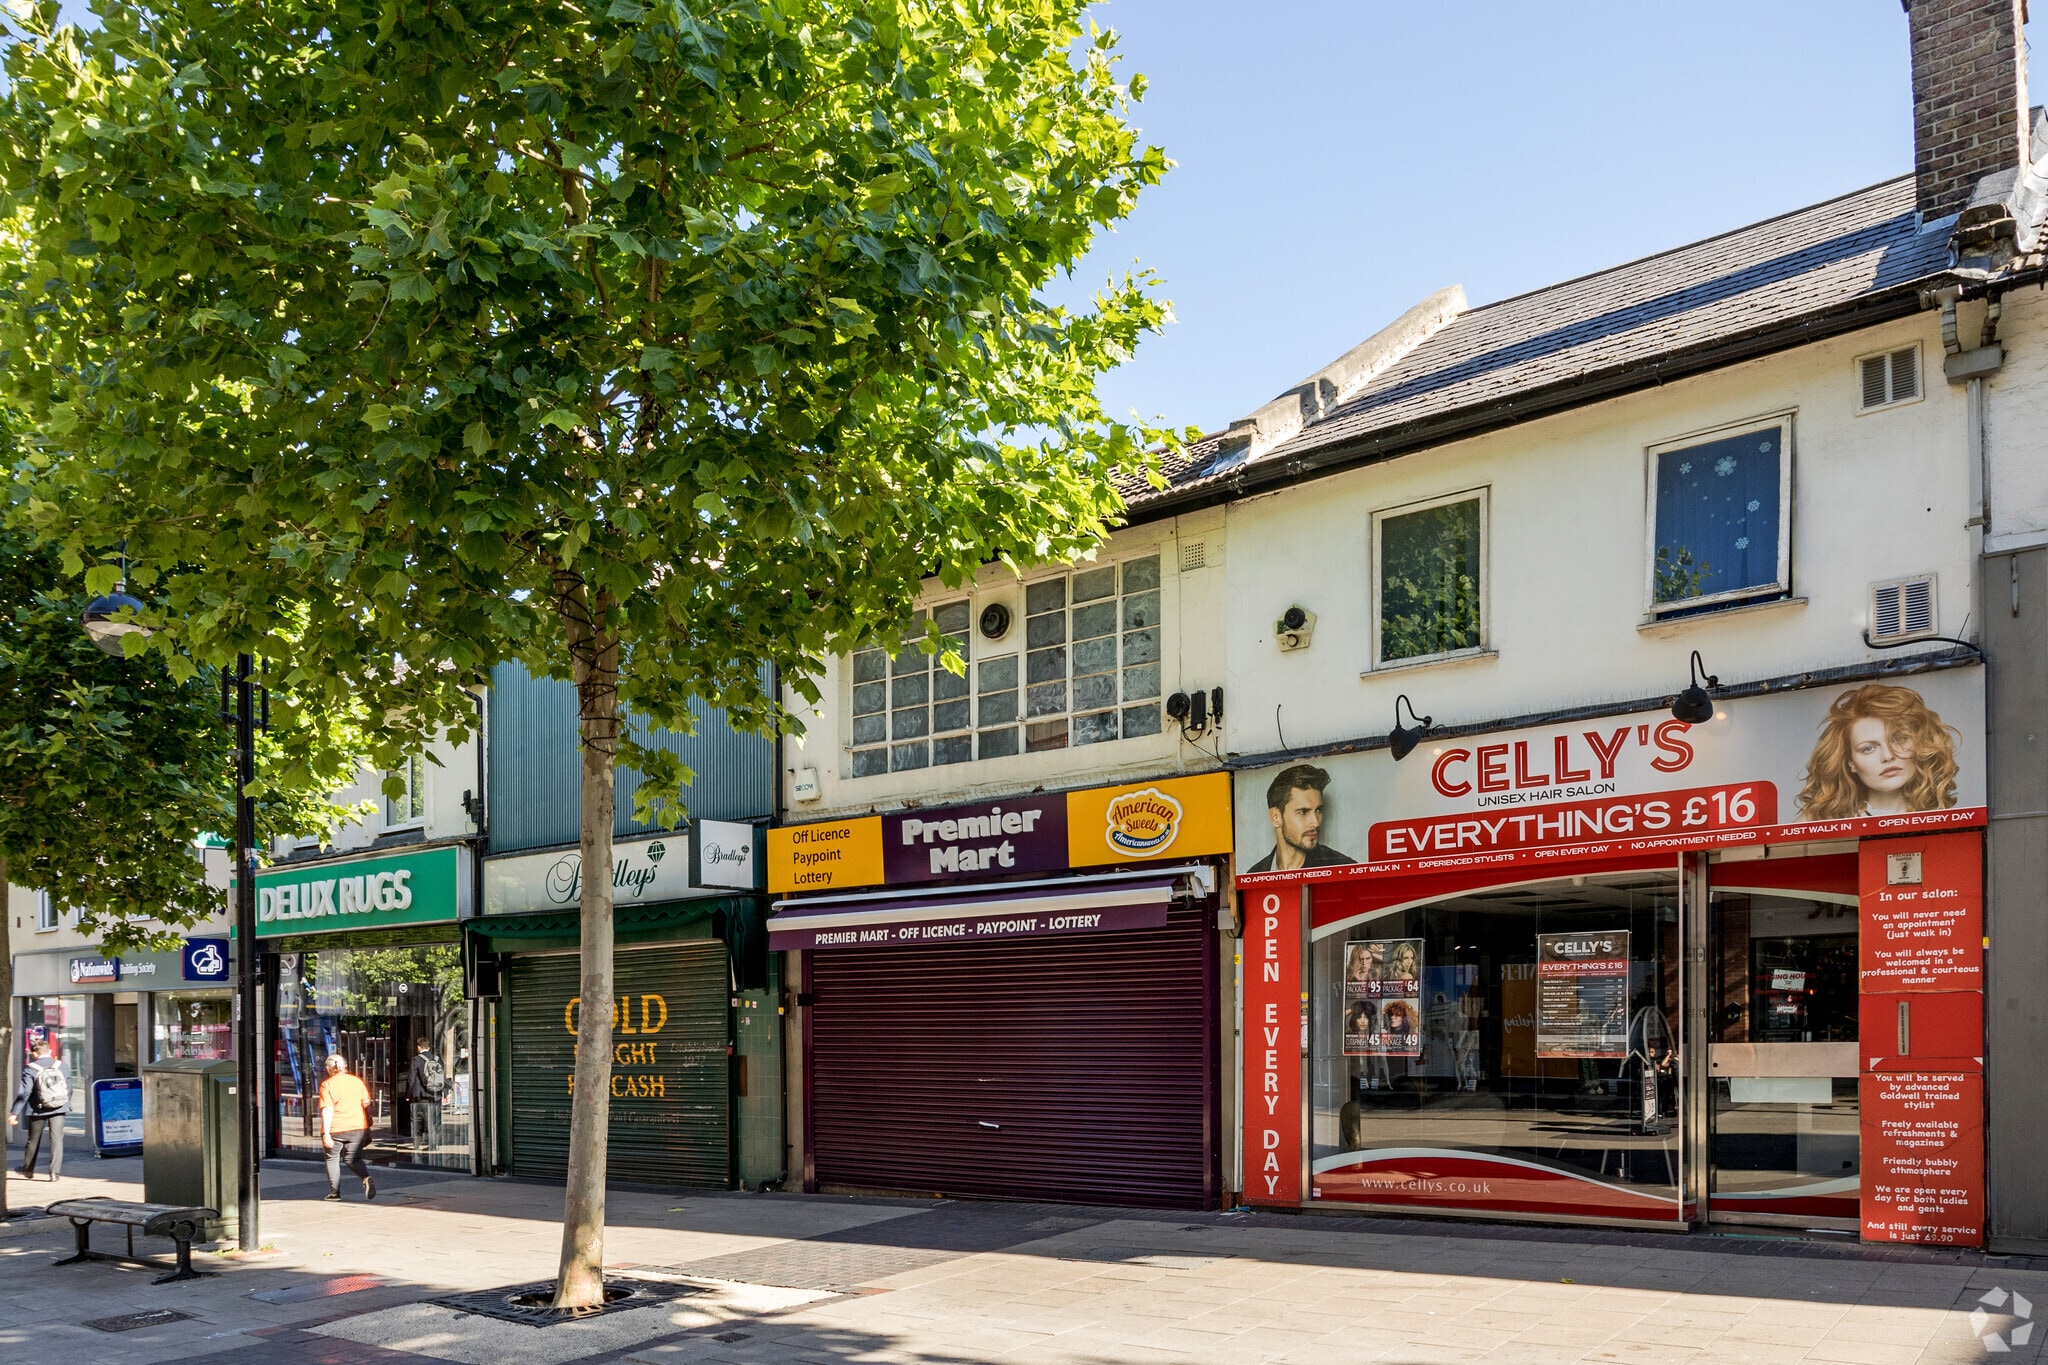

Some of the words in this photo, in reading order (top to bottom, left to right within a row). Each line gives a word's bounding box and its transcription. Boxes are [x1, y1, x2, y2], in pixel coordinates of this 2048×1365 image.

[1431, 719, 1694, 798] CELLY'S
[795, 783, 813, 791] SECOM
[1477, 793, 1527, 807] UNISEX
[1530, 788, 1562, 802] HAIR
[1566, 782, 1615, 798] SALON
[1112, 797, 1174, 825] American
[902, 806, 1042, 846] Premier
[1125, 818, 1160, 833] Sweets
[1386, 800, 1671, 854] EVERYTHING'S
[1682, 788, 1756, 827] £16
[792, 830, 808, 844] Off
[811, 827, 850, 842] Licence
[1252, 872, 1302, 883] APPOINTMENT
[1303, 869, 1332, 879] NEEDED
[1349, 866, 1369, 875] JUST
[1369, 864, 1391, 873] WALK
[1418, 857, 1473, 869] EXPERIENCED
[1474, 854, 1515, 863] STYLISTS
[1534, 848, 1559, 858] OPEN
[1560, 846, 1590, 856] EVERY
[1591, 844, 1610, 853] DAY
[1631, 841, 1646, 850] NO
[1647, 836, 1716, 848] APPOINTMENT
[1717, 831, 1756, 842] NEEDED
[1780, 827, 1807, 836] JUST
[1808, 824, 1840, 834] WALK
[1840, 822, 1852, 831] IN
[1878, 818, 1911, 828] OPEN
[1911, 814, 1949, 825] EVERY
[1952, 811, 1975, 821] DAY
[703, 843, 747, 866] Bradleys
[793, 848, 841, 866] Paypoint
[930, 839, 1015, 874] Mart
[794, 870, 833, 885] Lottery
[259, 879, 338, 922] DELUX
[339, 869, 413, 914] RUGS
[1879, 892, 1892, 902] In
[1897, 892, 1918, 901] our
[1922, 888, 1958, 899] salon:
[1872, 913, 1889, 921] You
[1943, 908, 1966, 917] need
[815, 931, 857, 945] PREMIER
[859, 929, 889, 942] MART
[899, 927, 919, 940] OFF
[922, 924, 965, 938] LICENCE
[977, 918, 1038, 935] PAYPOINT
[1049, 914, 1101, 930] LOTTERY
[1898, 918, 1956, 930] appointment
[1262, 894, 1280, 982] OPEN
[1886, 930, 1909, 940] (just
[1913, 929, 1935, 937] walk
[1939, 928, 1952, 937] in)
[1554, 940, 1612, 954] CELLY'S
[1874, 950, 1892, 958] You
[1895, 949, 1912, 957] will
[1916, 948, 1949, 958] always
[1952, 947, 1965, 955] be
[80, 960, 114, 977] Nationwide
[120, 963, 138, 976] Building
[138, 962, 156, 975] Society
[1542, 962, 1607, 971] EVERYTHING'S
[1885, 957, 1931, 967] welcomed
[1934, 957, 1943, 965] in
[1861, 967, 1916, 978] professional
[1920, 966, 1929, 974] &
[1932, 965, 1980, 974] courteous
[1902, 976, 1936, 984] manner
[1346, 984, 1367, 993] PACKAGE
[1383, 984, 1403, 993] PACKAGE
[1381, 1037, 1402, 1046] PACKAGE
[1263, 1003, 1280, 1115] EVERY
[1875, 1074, 1892, 1082] You
[1896, 1074, 1913, 1082] will
[1917, 1074, 1929, 1082] be
[1932, 1074, 1964, 1082] served
[611, 1075, 665, 1097] CASH
[1889, 1083, 1901, 1092] by
[1905, 1083, 1949, 1091] advanced
[1880, 1092, 1920, 1100] Goldwell
[1925, 1092, 1960, 1100] trained
[1904, 1101, 1936, 1110] stylist
[1881, 1120, 1911, 1129] Freely
[1915, 1121, 1959, 1129] available
[1883, 1129, 1946, 1138] refreshments
[1949, 1130, 1958, 1138] &
[1896, 1139, 1944, 1148] magazines
[1263, 1129, 1280, 1195] DAY
[1883, 1157, 1921, 1167] Friendly
[1925, 1158, 1958, 1168] bubbly
[1890, 1167, 1951, 1176] athmosphere
[1361, 1178, 1491, 1194] www.cellys.co.uk
[1875, 1185, 1891, 1193] We
[1914, 1187, 1936, 1196] open
[1940, 1188, 1967, 1197] every
[1874, 1194, 1892, 1203] day
[1895, 1194, 1910, 1202] for
[1914, 1195, 1936, 1203] both
[1939, 1196, 1969, 1205] ladies
[1897, 1204, 1914, 1212] and
[1918, 1205, 1945, 1214] gents
[1867, 1221, 1885, 1229] And
[1888, 1222, 1908, 1231] still
[1911, 1225, 1939, 1233] every
[1942, 1225, 1977, 1235] service
[1889, 1231, 1897, 1239] is
[1901, 1231, 1920, 1240] just
[1924, 1234, 1953, 1242] £9.90
